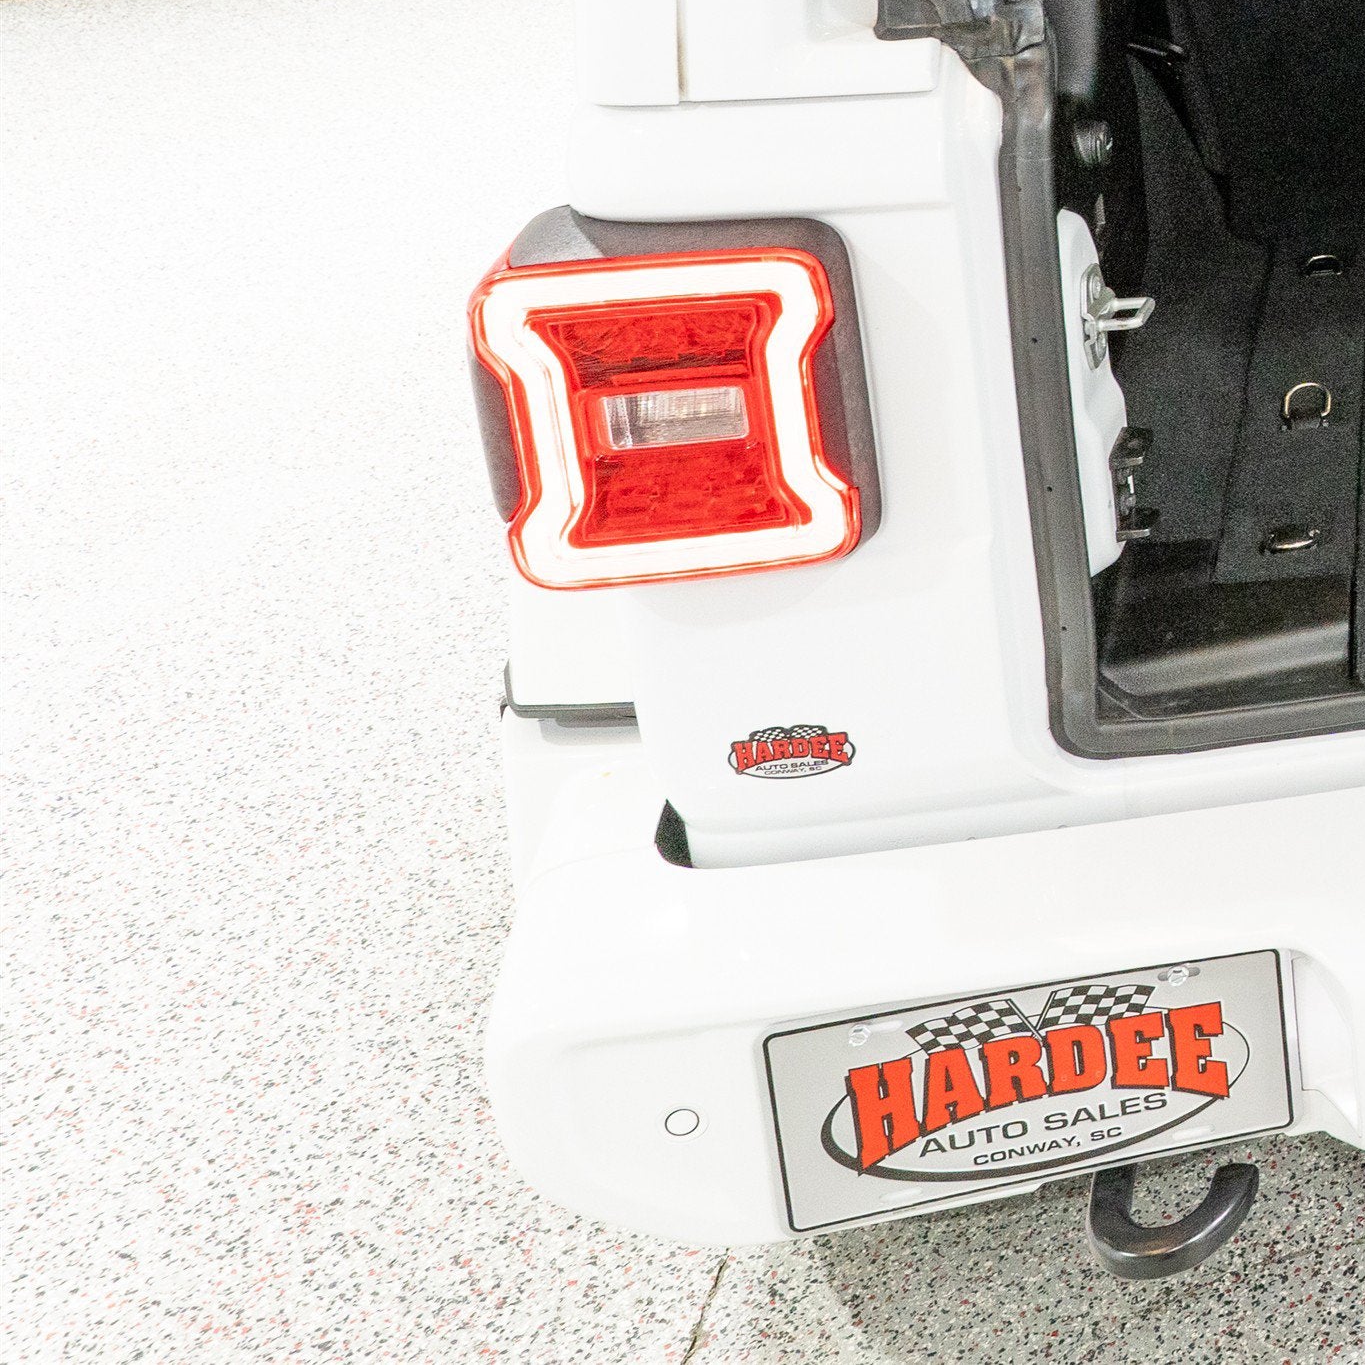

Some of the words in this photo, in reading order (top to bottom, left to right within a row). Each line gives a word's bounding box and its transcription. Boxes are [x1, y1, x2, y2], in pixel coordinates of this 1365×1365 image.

[731, 731, 849, 773] HARDEE
[755, 763, 788, 772] AUTO
[790, 759, 829, 769] SALES
[844, 1001, 1230, 1175] HARDEE
[919, 1120, 1028, 1158] AUTO
[1043, 1092, 1168, 1132] SALES
[973, 1135, 1082, 1166] CONWAY,
[1090, 1126, 1122, 1143] SC
